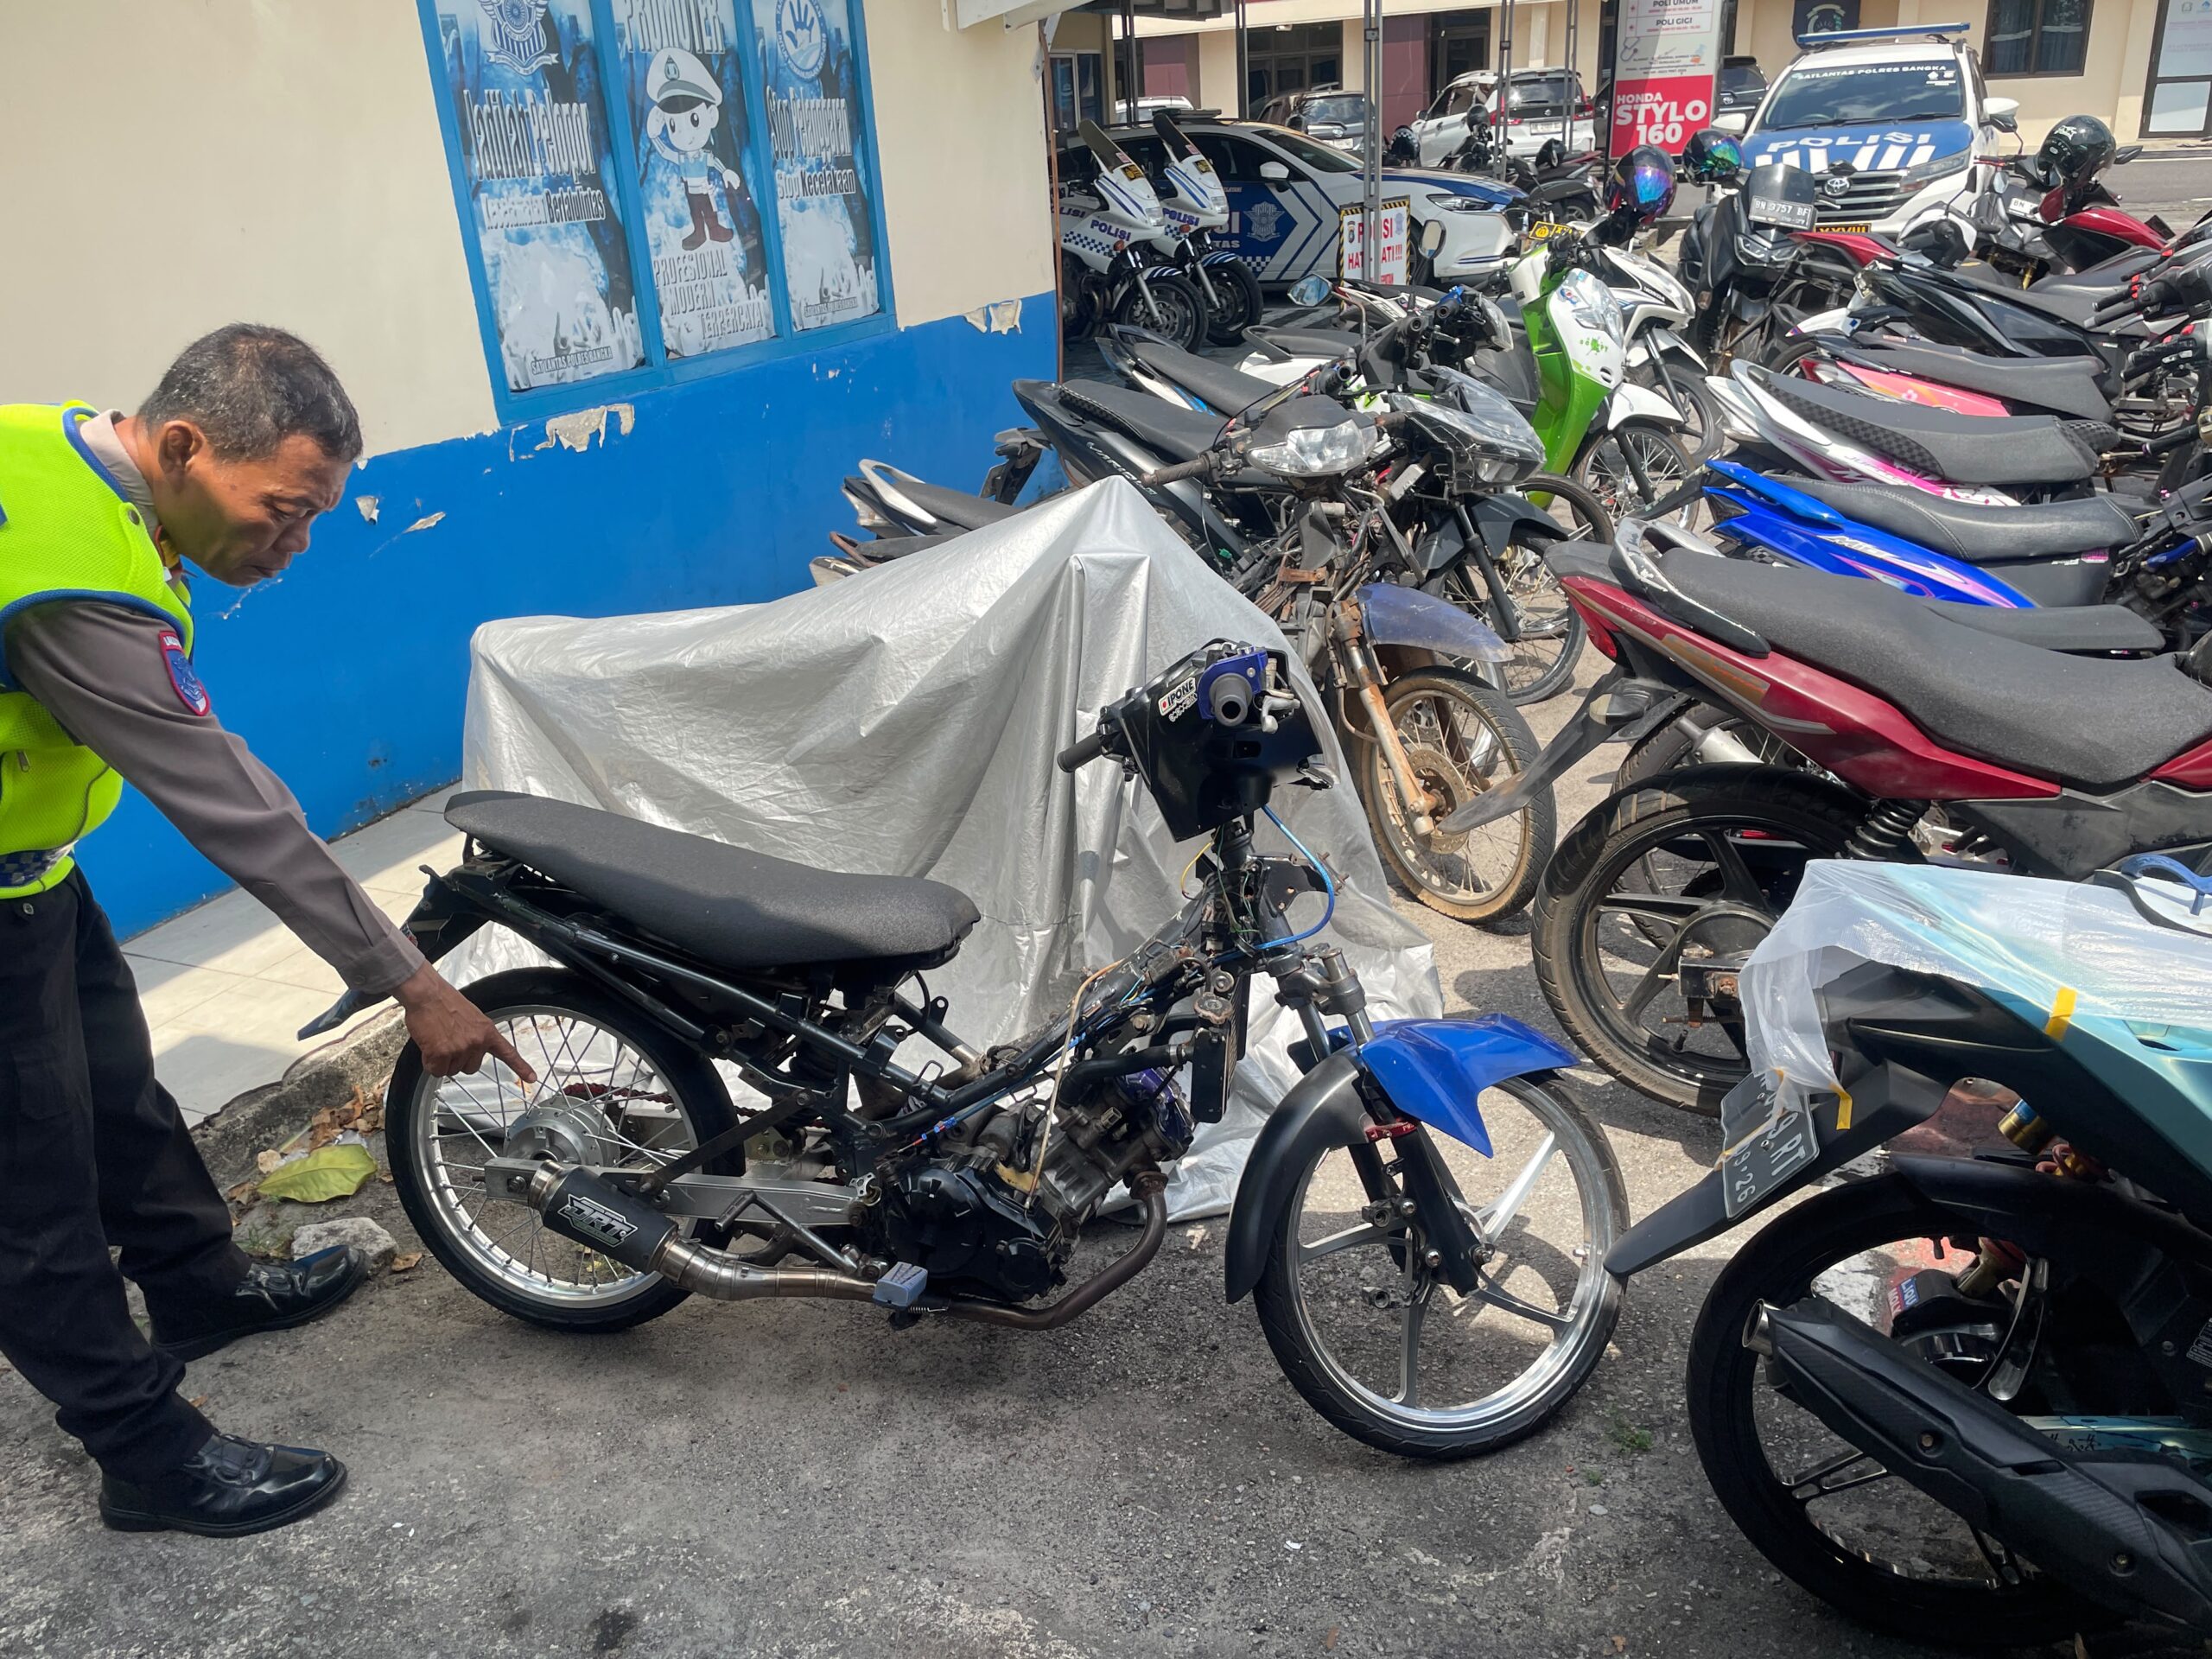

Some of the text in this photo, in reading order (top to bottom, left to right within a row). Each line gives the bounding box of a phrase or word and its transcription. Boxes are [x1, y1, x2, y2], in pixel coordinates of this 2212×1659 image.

[1797, 70, 1854, 80] SATLANTAS
[1858, 67, 1900, 75] POLRES
[1617, 92, 1663, 104] HONDA
[1615, 99, 1707, 125] STYLO
[524, 88, 596, 184] Pelopor
[1636, 122, 1682, 145] 160
[1766, 131, 1931, 152] POLISI
[800, 168, 856, 197] Kecelakaan
[1162, 207, 1200, 226] POLISI
[1090, 219, 1131, 242] POLISI
[653, 249, 728, 288] PROFESIONAL
[669, 281, 716, 315] MODERN
[1167, 679, 1193, 707] IPONE
[1901, 1279, 1917, 1306] LIQU
